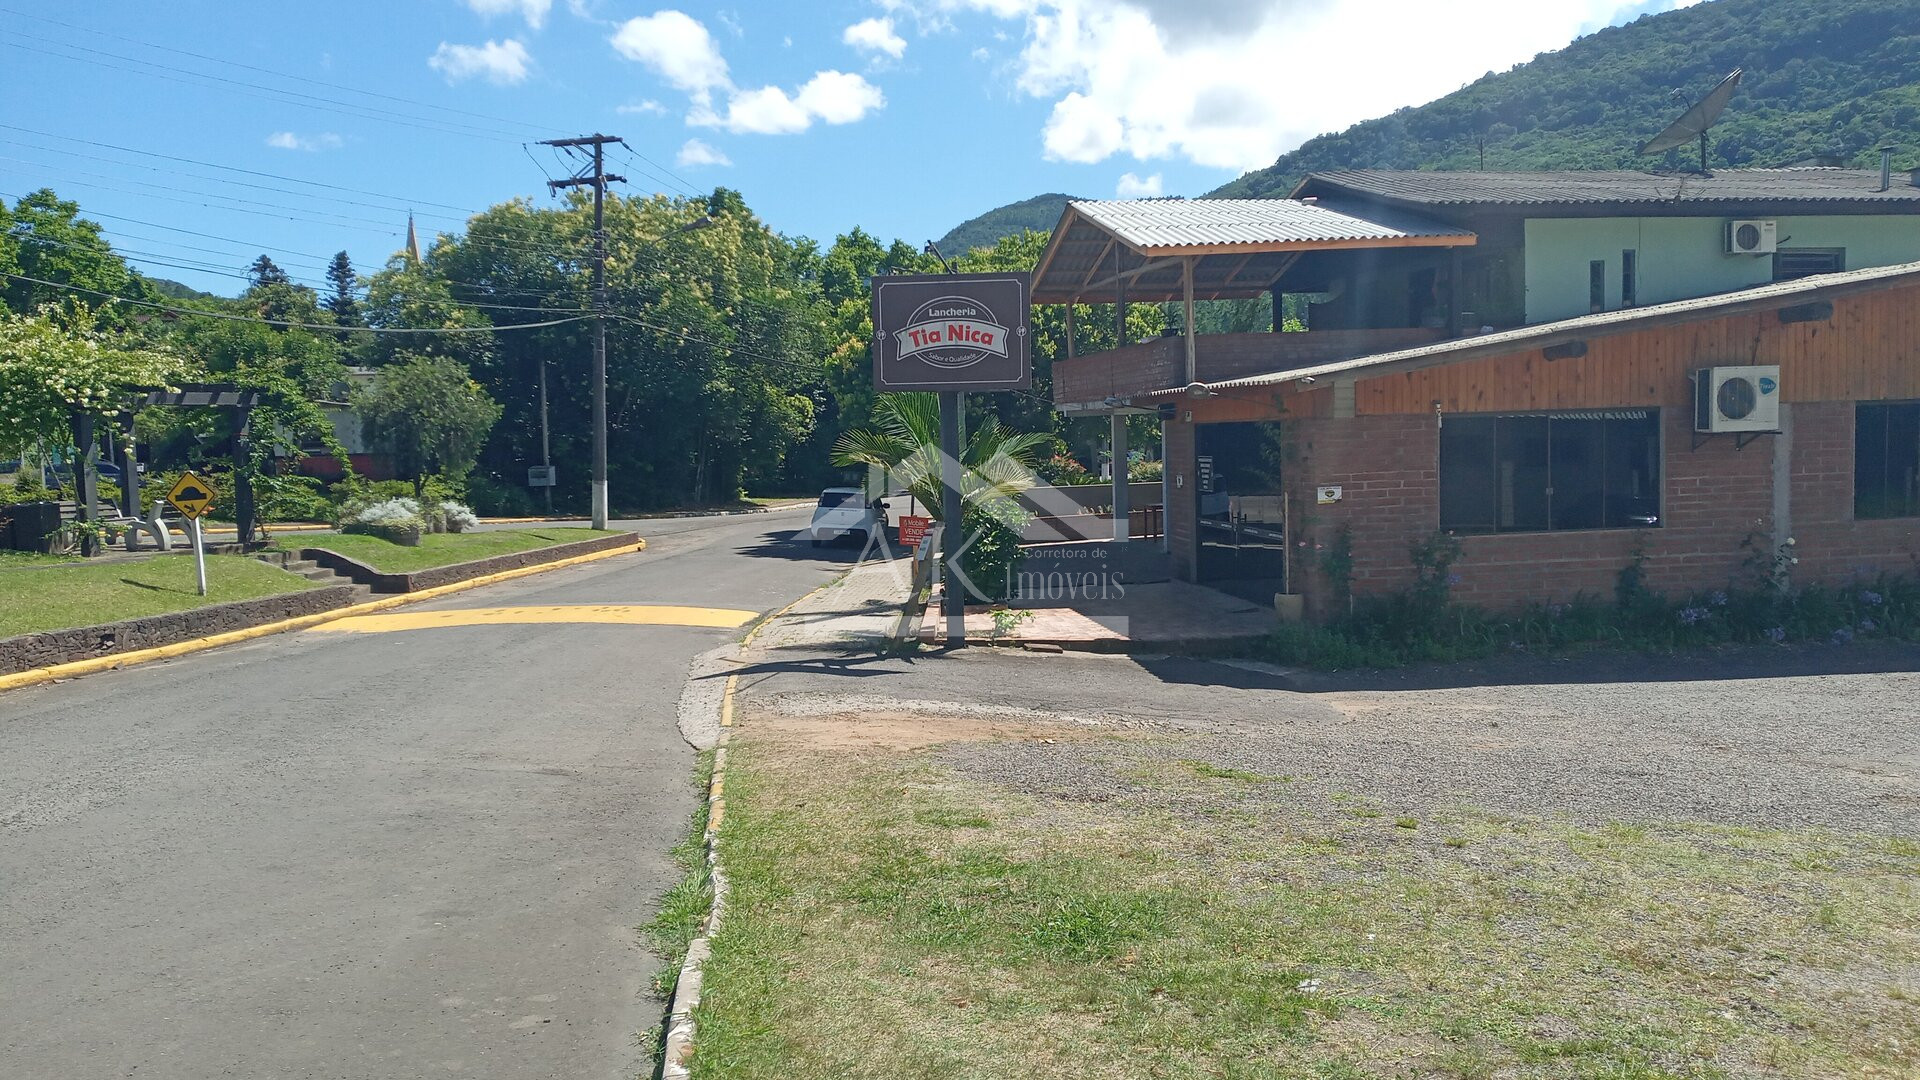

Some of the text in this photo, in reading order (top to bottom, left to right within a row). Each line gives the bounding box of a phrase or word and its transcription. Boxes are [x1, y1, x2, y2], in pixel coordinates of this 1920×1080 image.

[928, 307, 976, 317] Lancheria
[908, 324, 994, 348] Tia Nica
[904, 528, 924, 536] VENDE
